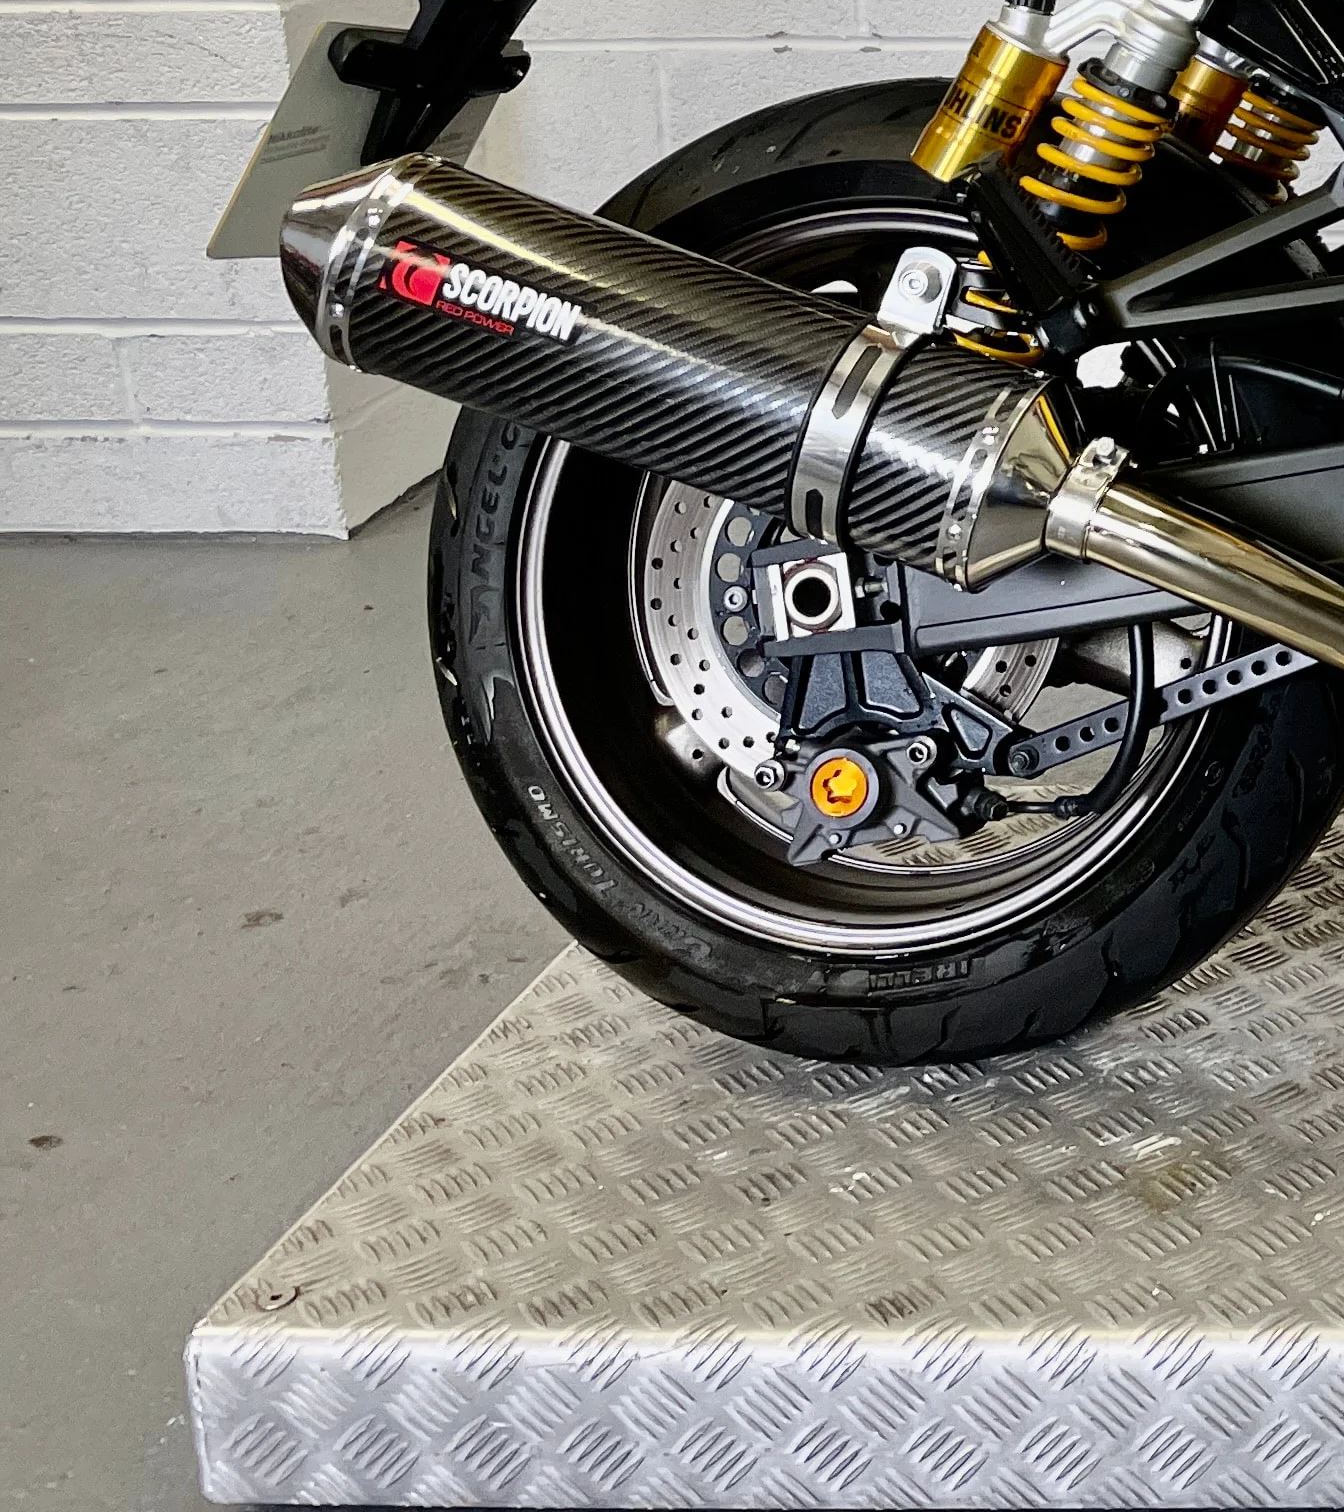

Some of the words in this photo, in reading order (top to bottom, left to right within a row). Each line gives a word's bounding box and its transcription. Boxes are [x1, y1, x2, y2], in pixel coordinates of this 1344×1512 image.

[436, 300, 463, 317] RED
[464, 311, 516, 336] POWER
[442, 263, 582, 340] SCORPION
